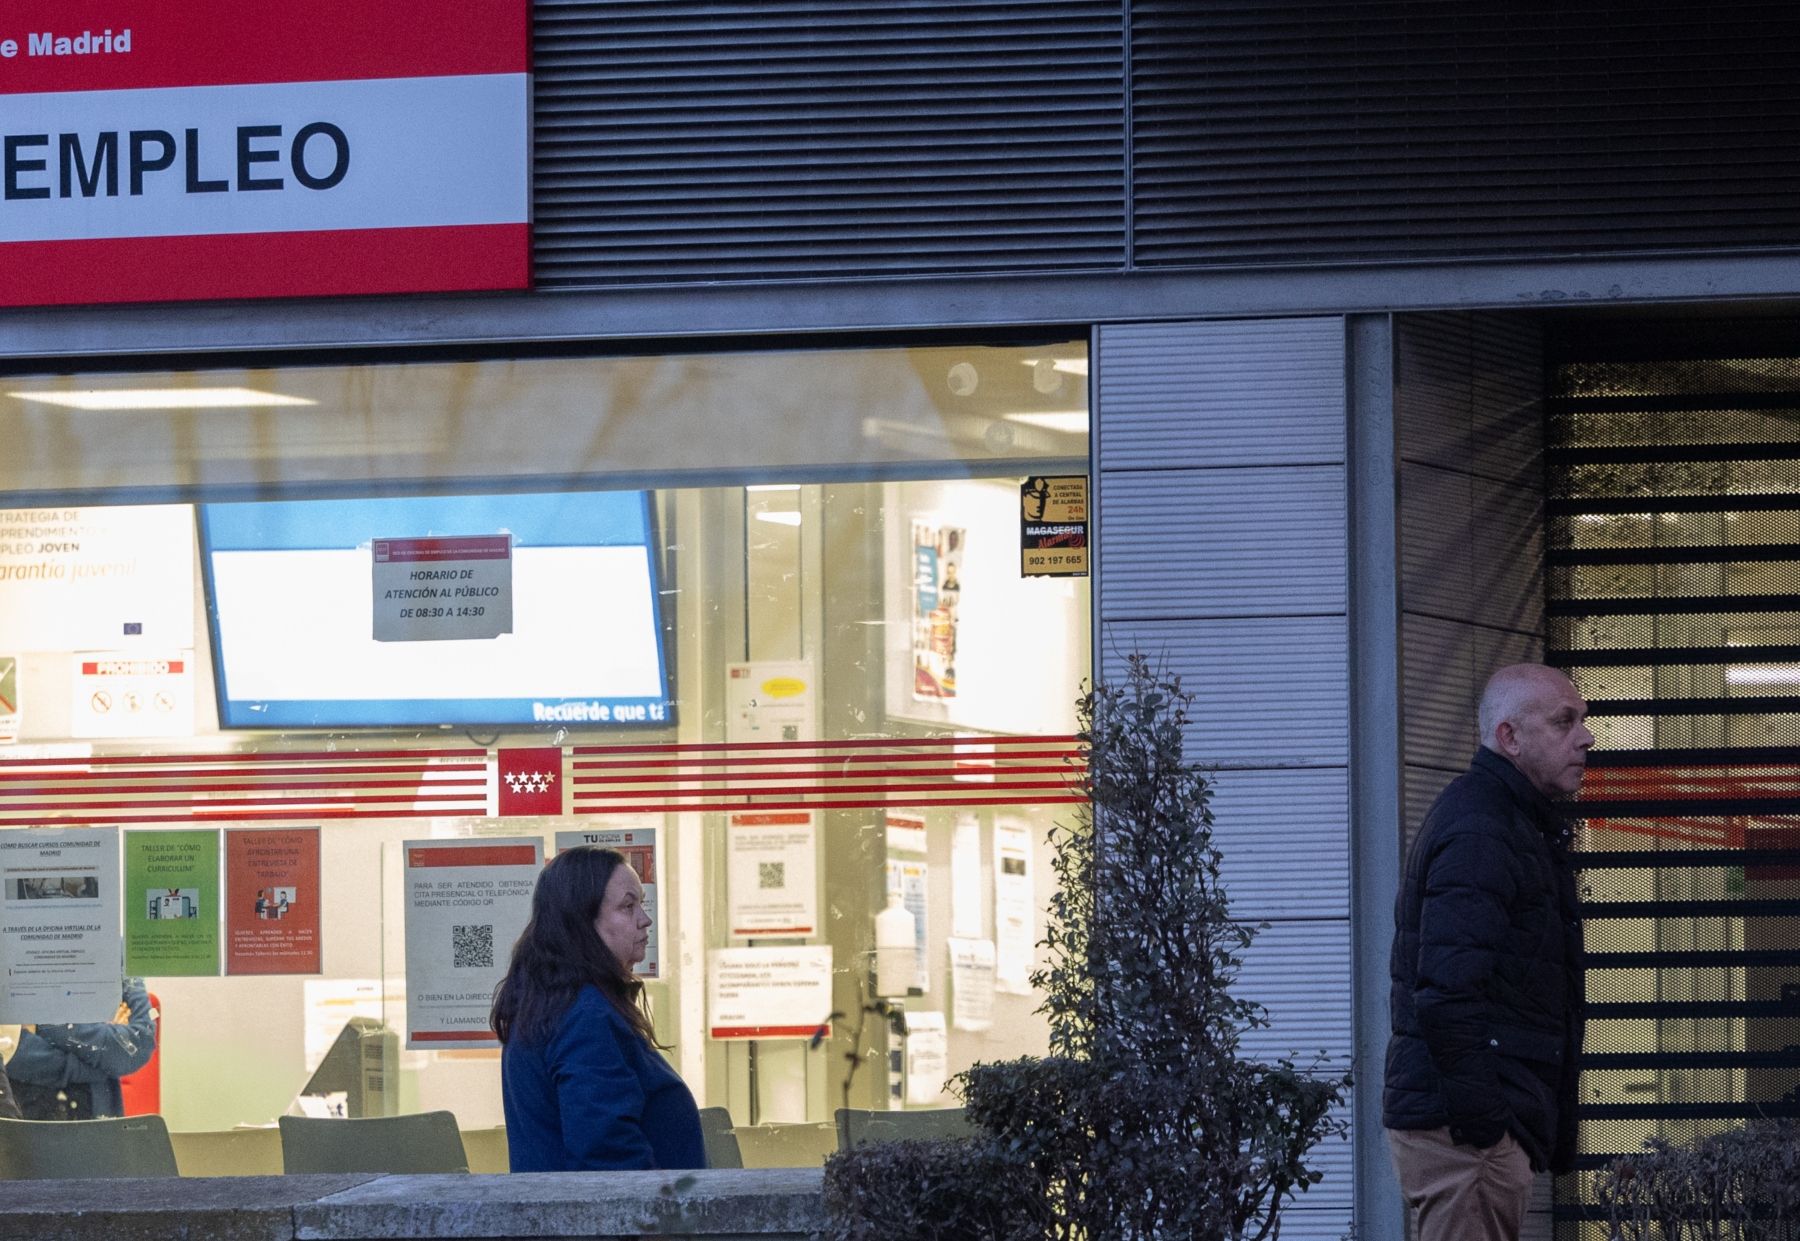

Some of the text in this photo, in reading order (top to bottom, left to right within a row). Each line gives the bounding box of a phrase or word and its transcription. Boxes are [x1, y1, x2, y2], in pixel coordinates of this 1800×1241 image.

[0, 29, 131, 57] e Madrid
[4, 122, 350, 200] EMPLEO
[1067, 505, 1084, 514] 24h
[64, 511, 80, 522] DE
[1026, 525, 1084, 536] MAGASEGUR
[38, 542, 80, 554] JOVEN
[1029, 555, 1082, 565] 902 197 665
[410, 569, 474, 580] HORARIO DE
[384, 585, 499, 599] ATENCIÓN AL PÚBLICO
[400, 606, 485, 618] DE 08:30 A 14:30
[532, 700, 610, 721] Recuerde
[613, 704, 646, 723] que
[584, 834, 598, 843] TU
[60, 840, 93, 848] COMUNIDAD
[93, 840, 102, 848] DE
[142, 844, 165, 852] TALLER
[184, 854, 194, 862] UN
[414, 879, 534, 890] PARA SER ATENDIDO OBTENGA
[431, 889, 476, 898] PRESENCIAL
[477, 889, 484, 897] O
[485, 888, 530, 897] TELEFÓNICA
[414, 899, 451, 907] MEDIANTE
[452, 898, 481, 906] CÓDIGO
[21, 933, 54, 941] COMUNIDAD
[425, 993, 443, 1001] BIEN
[444, 993, 454, 1001] EN
[446, 1016, 488, 1025] LLAMANDO
